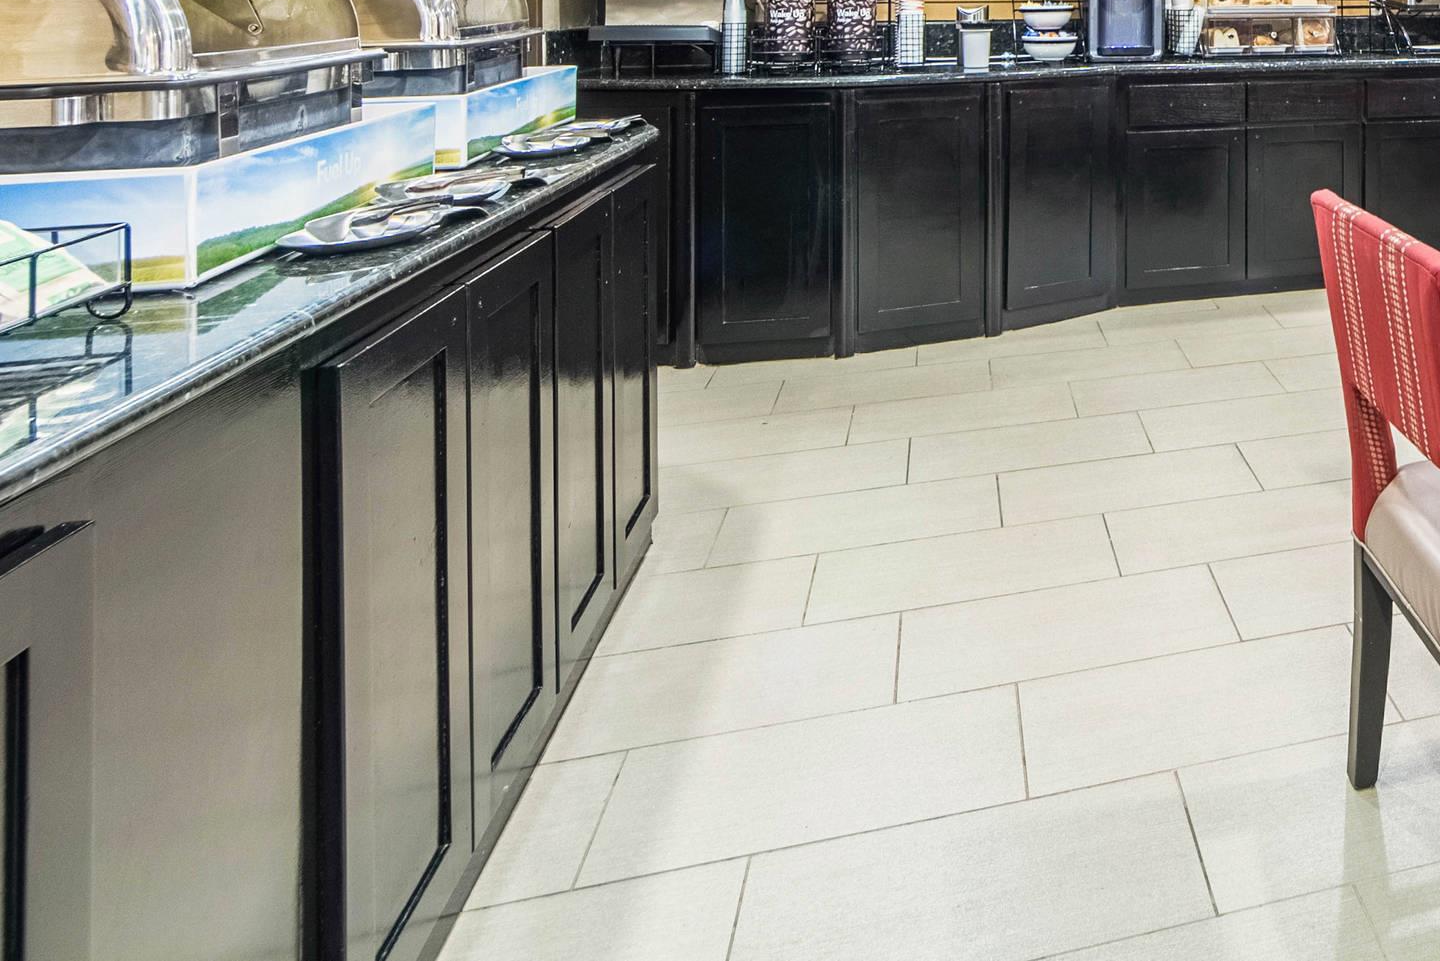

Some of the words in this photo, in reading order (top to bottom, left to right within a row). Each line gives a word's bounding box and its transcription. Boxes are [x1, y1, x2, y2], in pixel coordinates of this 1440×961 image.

[769, 8, 792, 18] Wake
[792, 7, 805, 19] Up
[836, 8, 858, 18] Wake
[860, 7, 872, 19] Up
[316, 152, 344, 183] Fuel
[344, 150, 362, 175] Up
